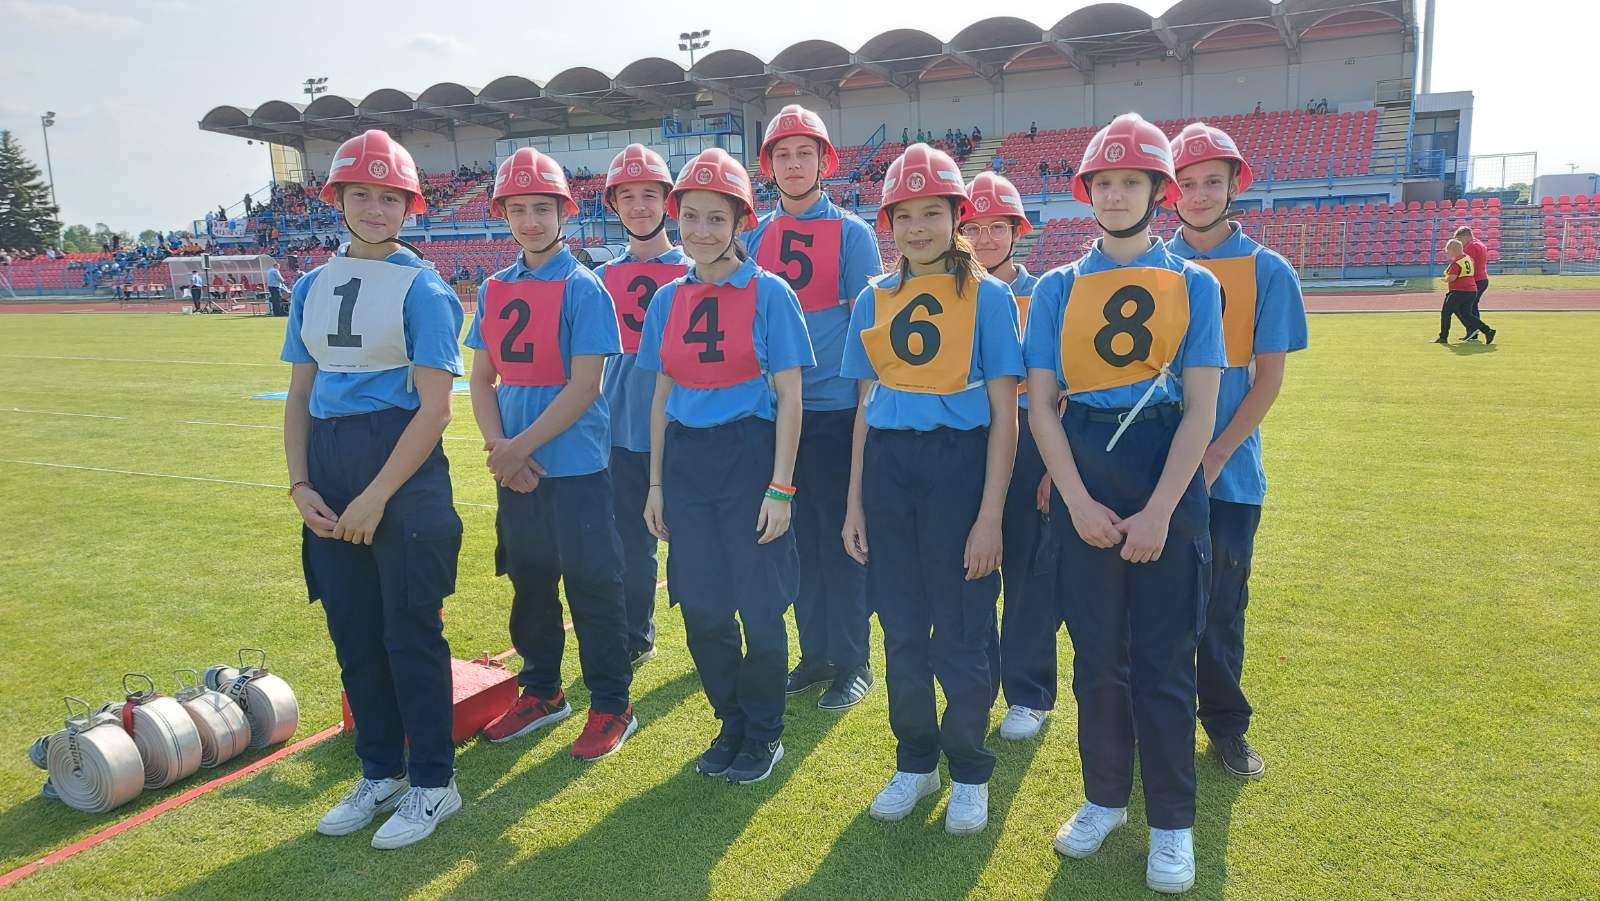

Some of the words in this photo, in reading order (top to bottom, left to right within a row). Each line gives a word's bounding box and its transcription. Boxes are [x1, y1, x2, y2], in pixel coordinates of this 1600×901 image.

[775, 230, 815, 291] 5
[1464, 260, 1471, 275] 9
[328, 278, 363, 348] 1
[499, 298, 535, 364] 2
[622, 275, 660, 333] 3
[682, 296, 726, 364] 4
[889, 292, 944, 366] 6
[1094, 285, 1156, 368] 8
